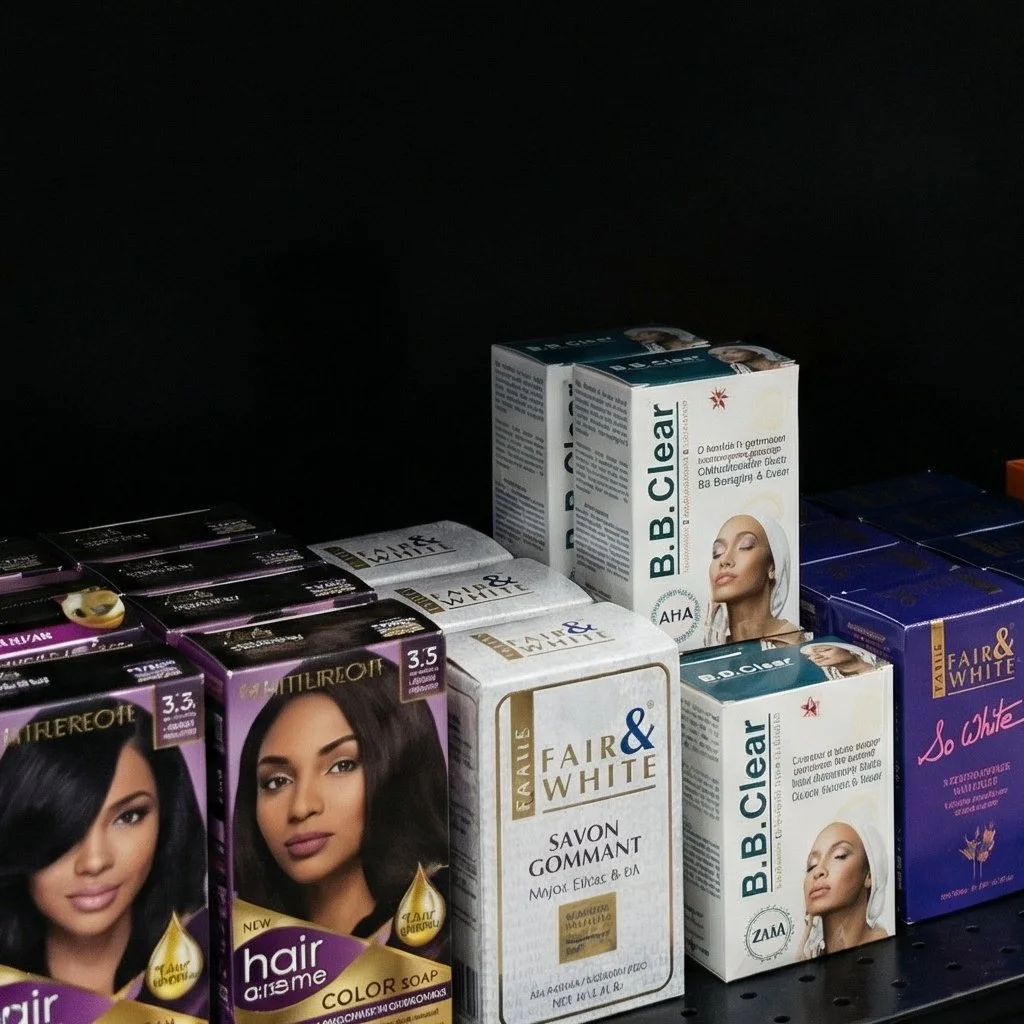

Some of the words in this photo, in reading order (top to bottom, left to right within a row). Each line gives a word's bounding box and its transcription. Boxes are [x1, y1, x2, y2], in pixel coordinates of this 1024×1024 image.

[948, 657, 1016, 688] WHITE
[918, 718, 954, 766] So
[542, 753, 656, 802] WHITE
[548, 819, 620, 853] SAVON
[528, 834, 643, 878] GOMMANT
[242, 918, 272, 934] NEW
[243, 934, 324, 983] hair
[321, 977, 396, 1011] COLOR
